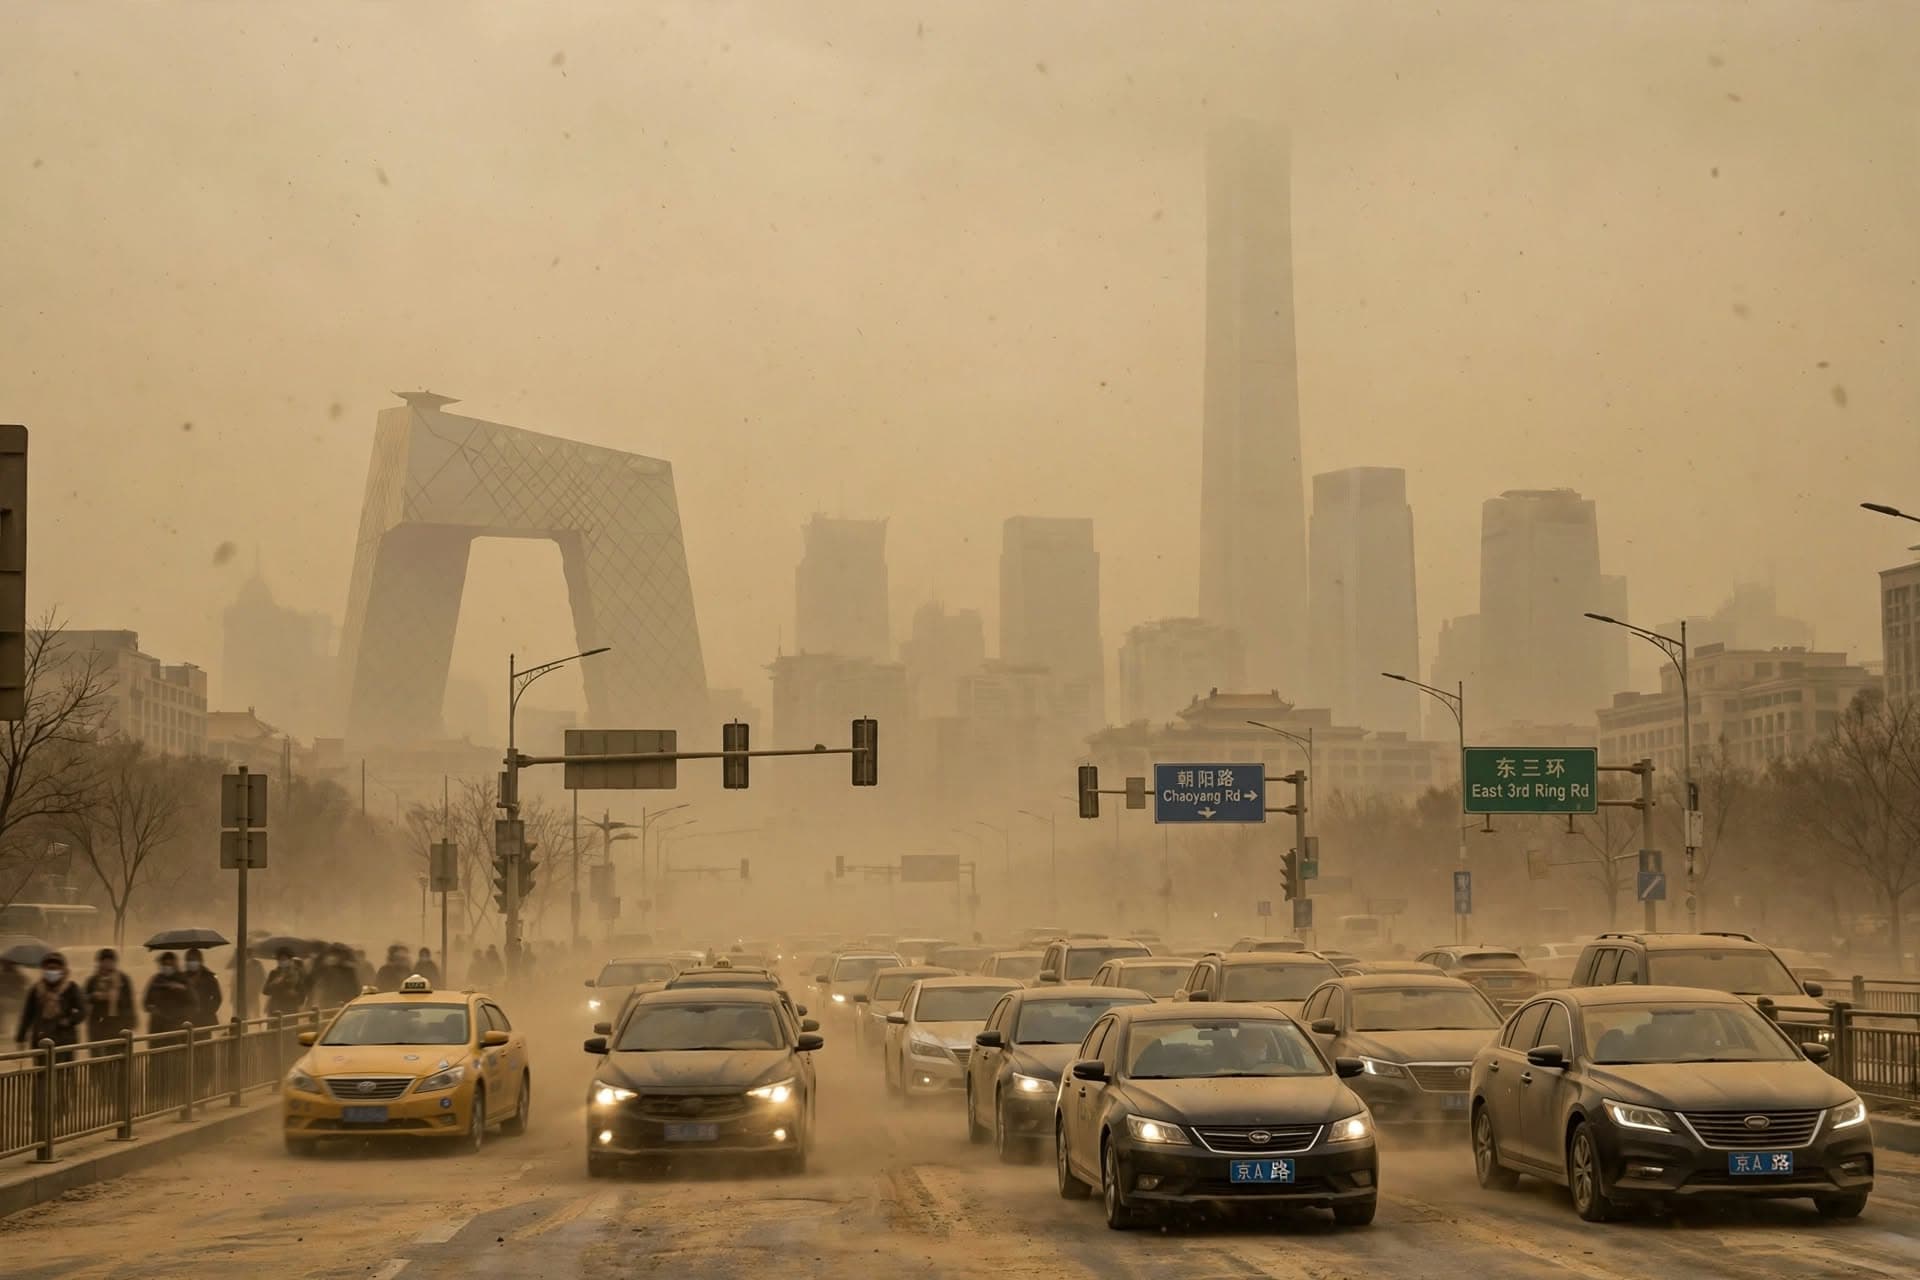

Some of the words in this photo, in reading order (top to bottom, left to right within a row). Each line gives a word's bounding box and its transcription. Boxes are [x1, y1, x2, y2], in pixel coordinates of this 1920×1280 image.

[1496, 757, 1565, 778] 东三环
[1177, 769, 1234, 788] 朝阳路
[1163, 789, 1221, 805] Chaoyang
[1225, 789, 1241, 802] Rd
[1472, 784, 1503, 798] East
[1507, 784, 1529, 798] 3rd
[1535, 784, 1566, 801] Ring
[1571, 784, 1589, 798] Rd
